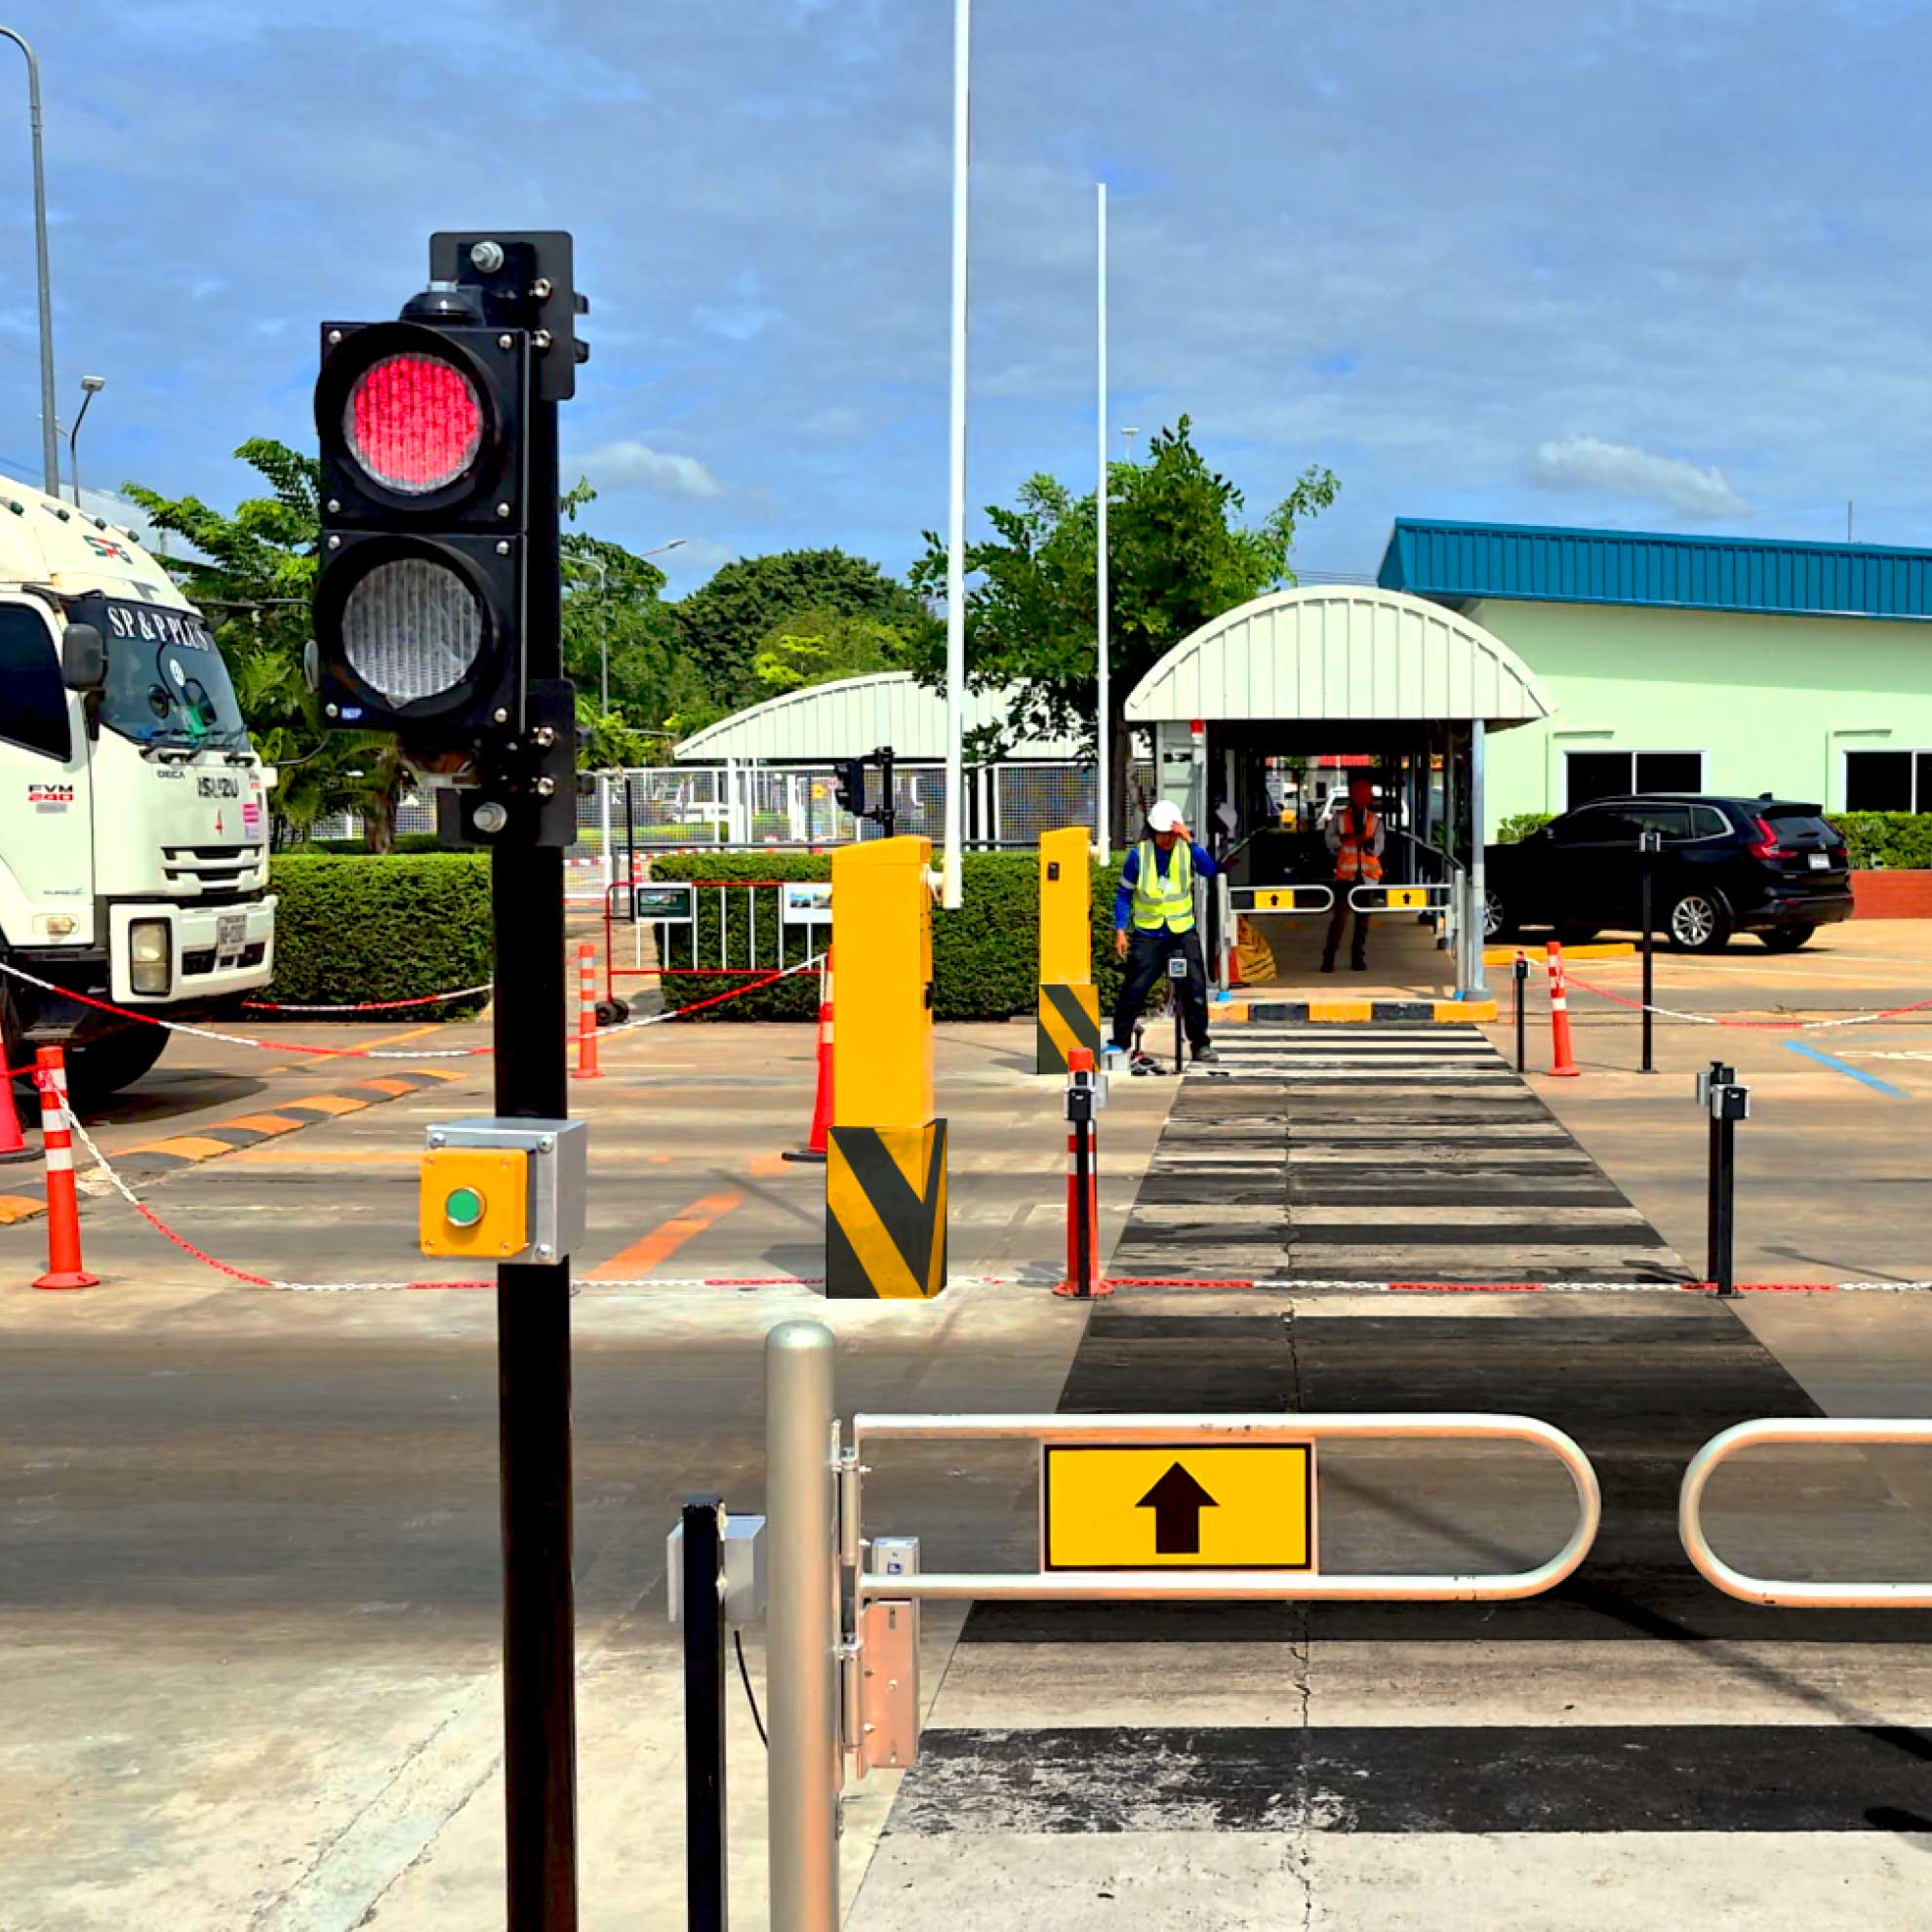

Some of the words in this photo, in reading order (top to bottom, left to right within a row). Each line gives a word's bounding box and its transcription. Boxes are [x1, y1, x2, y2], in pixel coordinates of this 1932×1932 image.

[107, 605, 136, 638] SP
[28, 784, 73, 792] FVM
[198, 775, 239, 799] ISUZU
